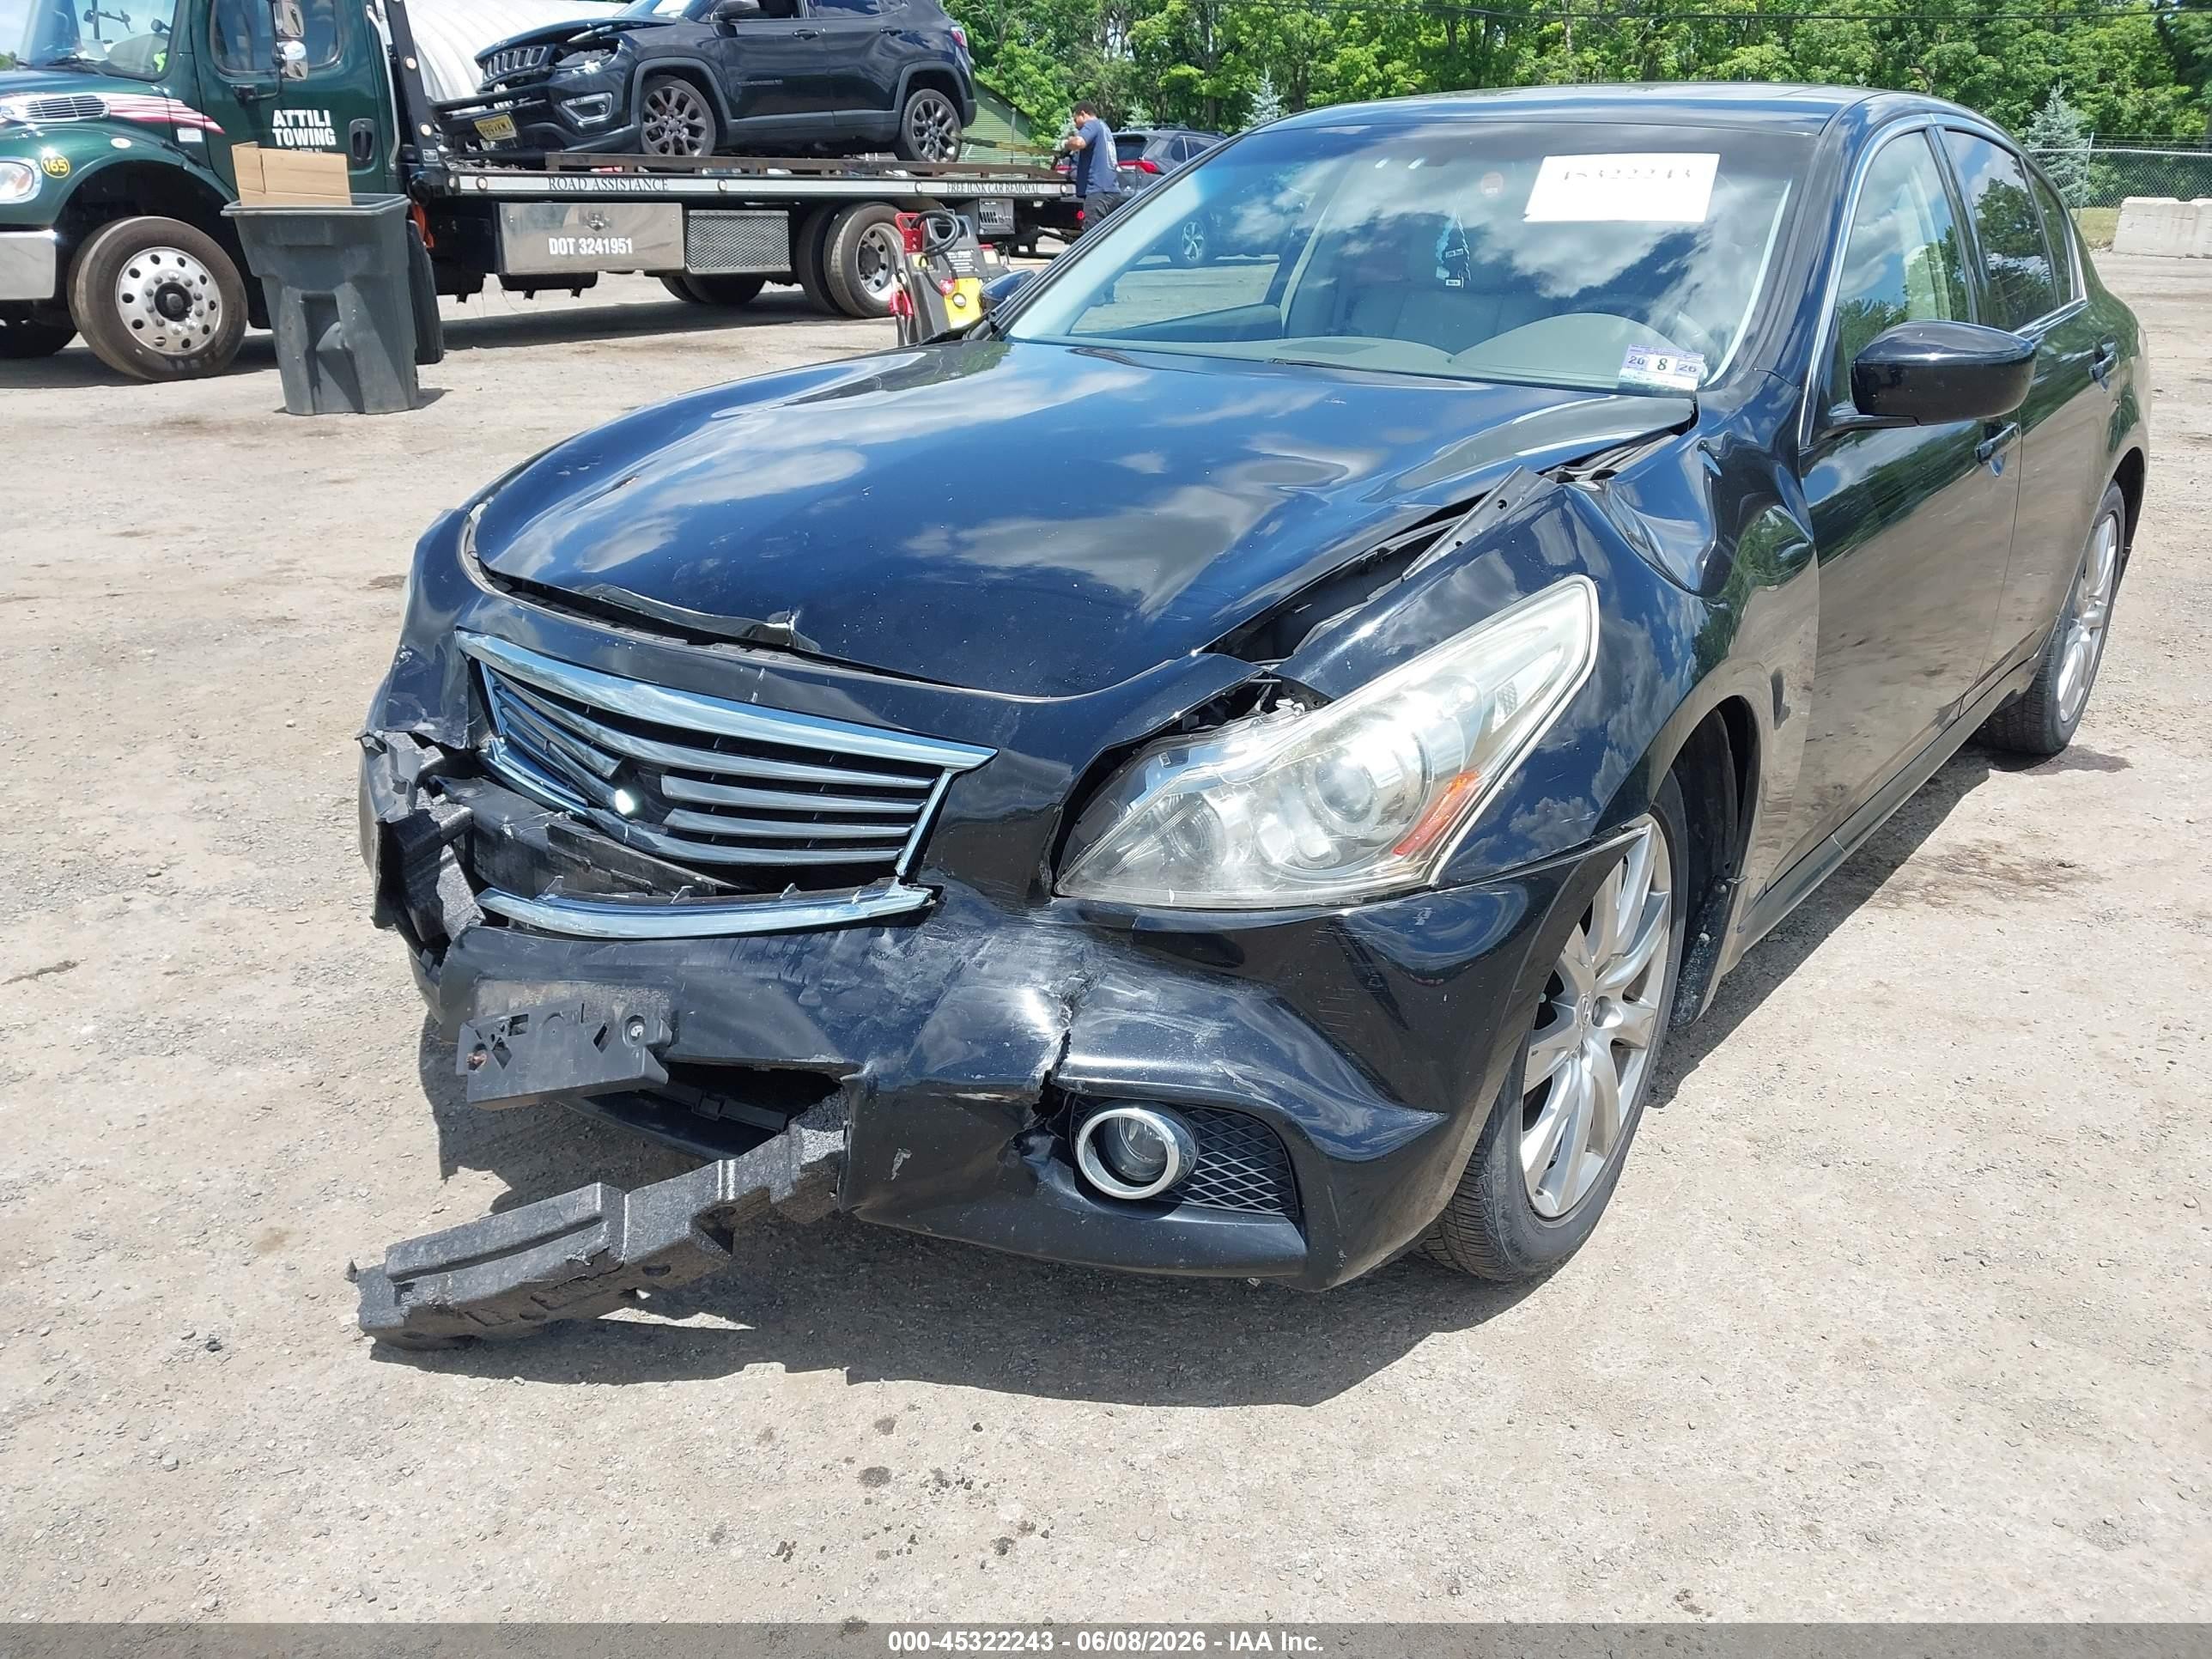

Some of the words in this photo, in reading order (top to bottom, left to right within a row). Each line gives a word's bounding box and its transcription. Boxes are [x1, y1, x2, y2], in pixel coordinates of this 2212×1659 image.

[272, 109, 332, 127] ATTILI
[271, 128, 337, 147] TOWING
[43, 158, 68, 173] 165
[548, 177, 587, 191] ROAD
[592, 177, 668, 191] ASSISTANCE
[946, 181, 965, 194] FREE
[988, 182, 1004, 194] CAR
[1006, 182, 1040, 195] REMOVAL
[548, 237, 575, 255] DOT
[579, 237, 633, 255] 3241951
[1627, 355, 1646, 367] 20
[1656, 357, 1668, 371] 8
[1679, 362, 1698, 374] 26
